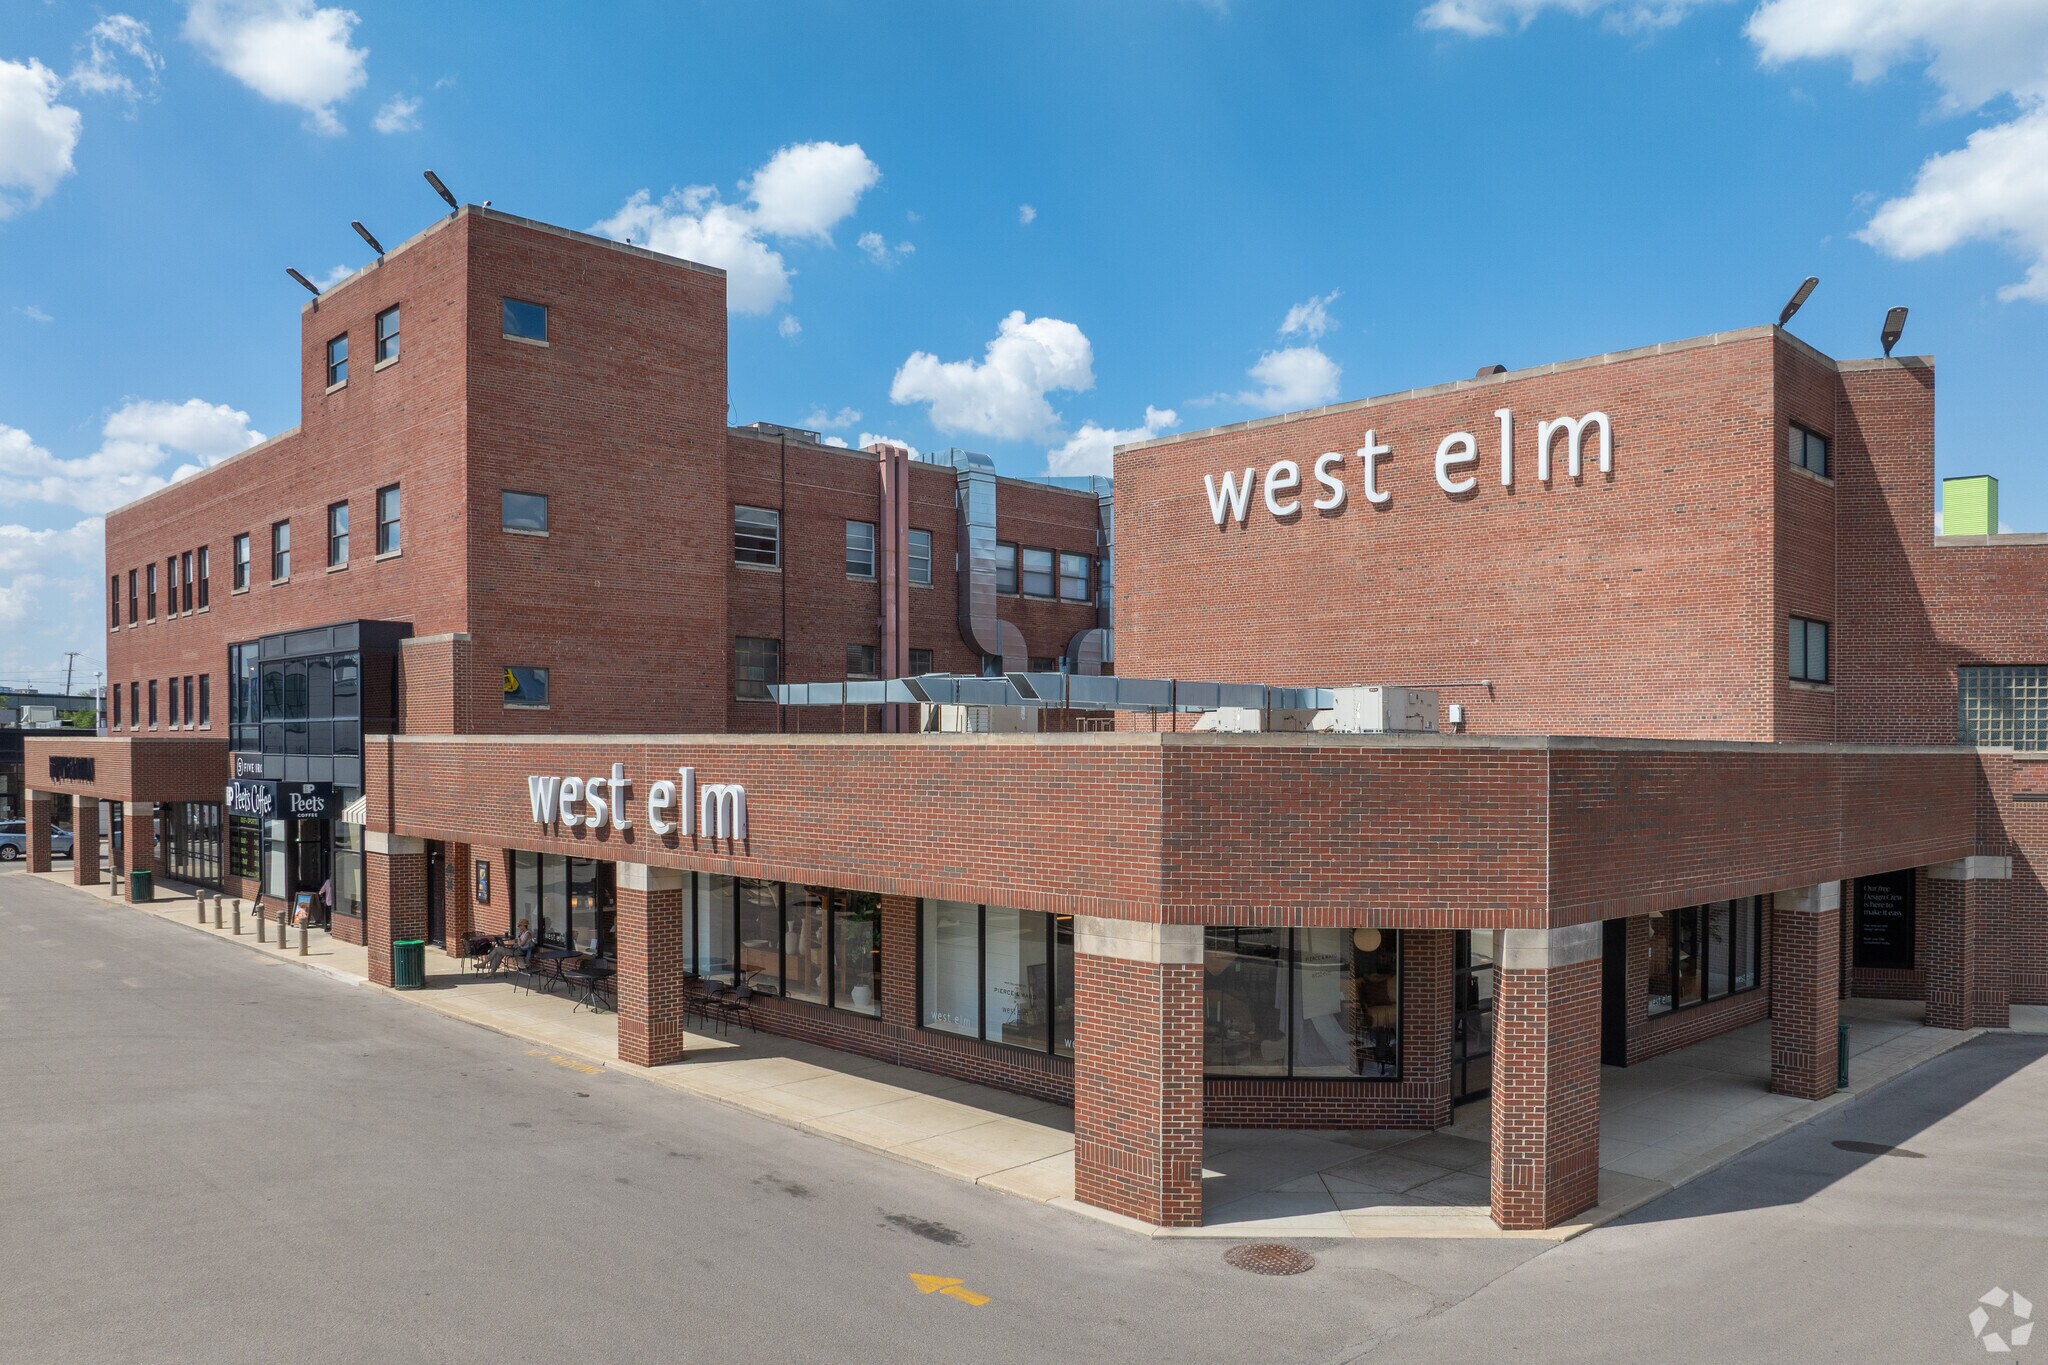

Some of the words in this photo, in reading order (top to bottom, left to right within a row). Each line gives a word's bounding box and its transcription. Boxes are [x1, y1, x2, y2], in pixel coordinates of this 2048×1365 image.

[1204, 428, 1392, 525] west
[1435, 407, 1612, 494] elm
[243, 763, 254, 773] FIVE
[234, 782, 250, 812] Peet's
[251, 784, 272, 816] Coffee
[289, 793, 324, 812] Peet's
[528, 762, 633, 830] west
[648, 766, 747, 840] elm
[994, 988, 1014, 996] PIERCE
[931, 1011, 951, 1023] west
[954, 1016, 970, 1026] elm
